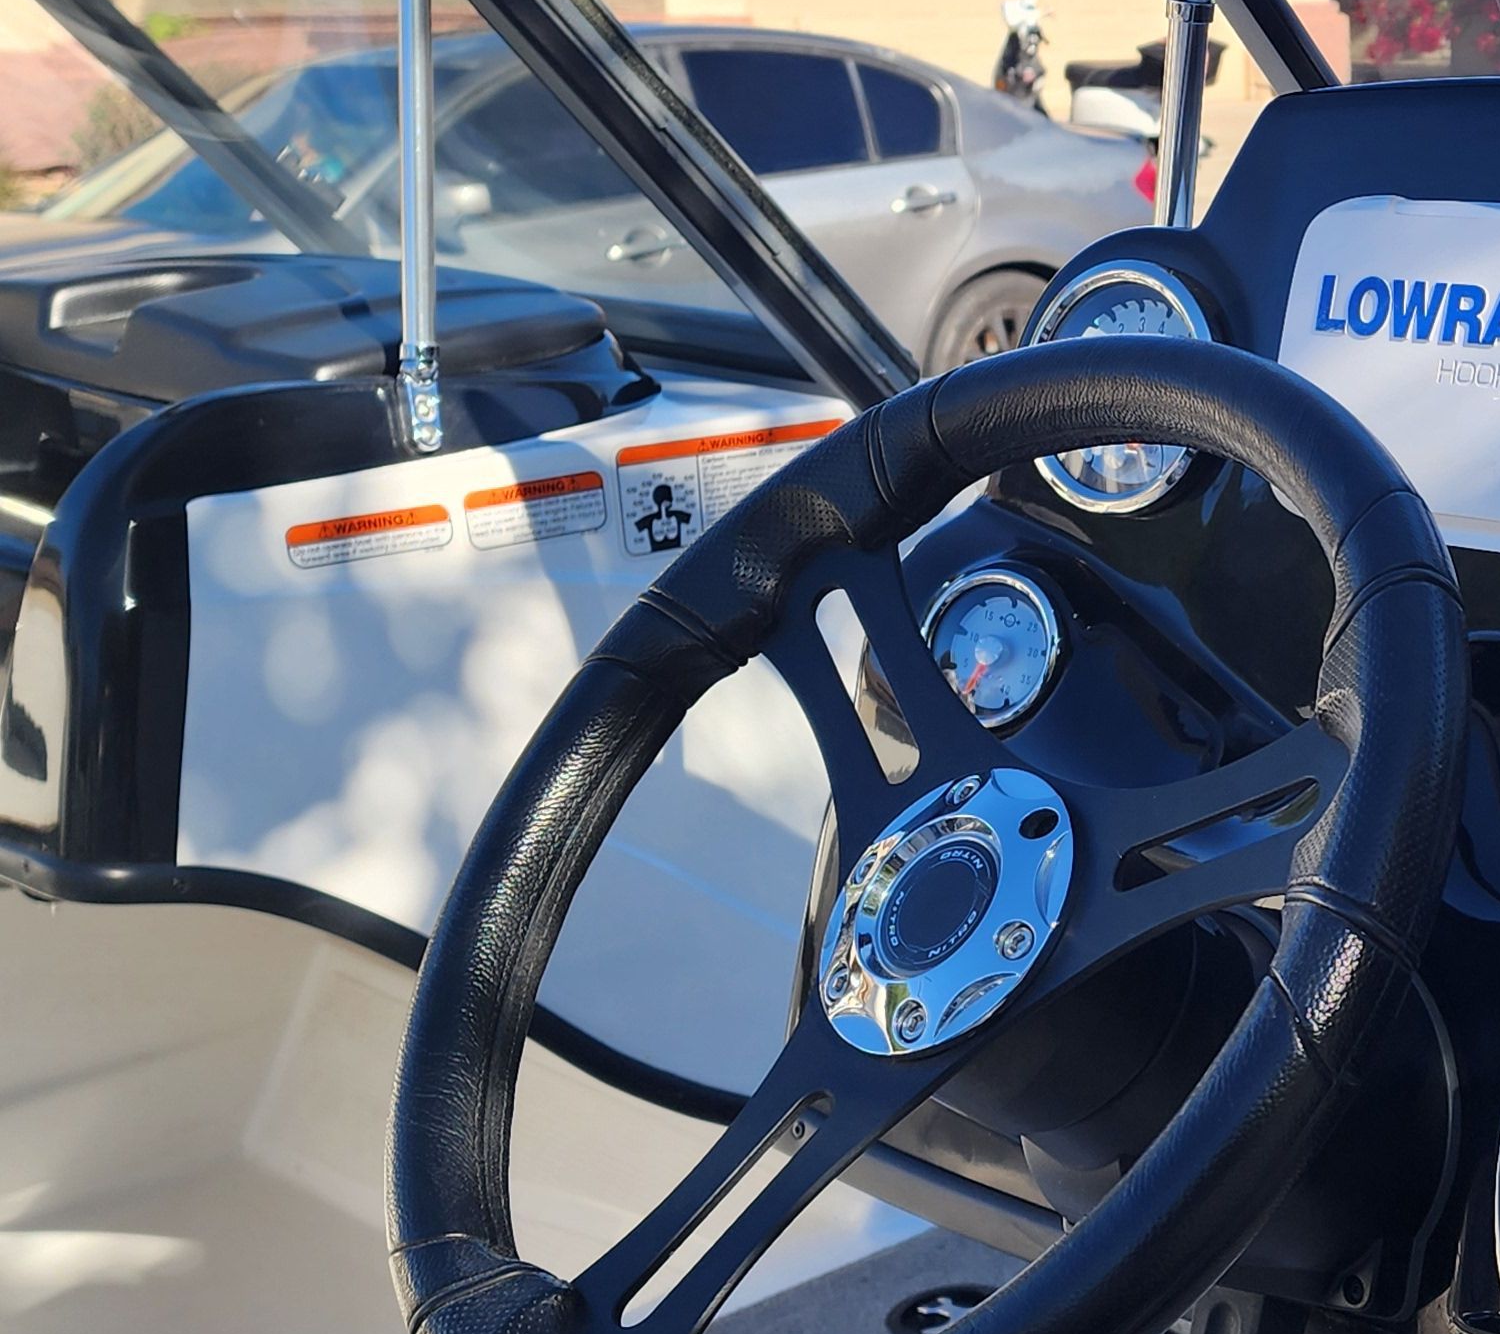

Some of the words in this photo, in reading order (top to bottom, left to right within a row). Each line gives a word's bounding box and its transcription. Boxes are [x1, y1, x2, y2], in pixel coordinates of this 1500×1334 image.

[1138, 316, 1146, 334] 3
[709, 432, 764, 450] WARNING
[503, 480, 565, 500] WARNING
[334, 514, 404, 535] WARNING
[984, 610, 994, 621] 15
